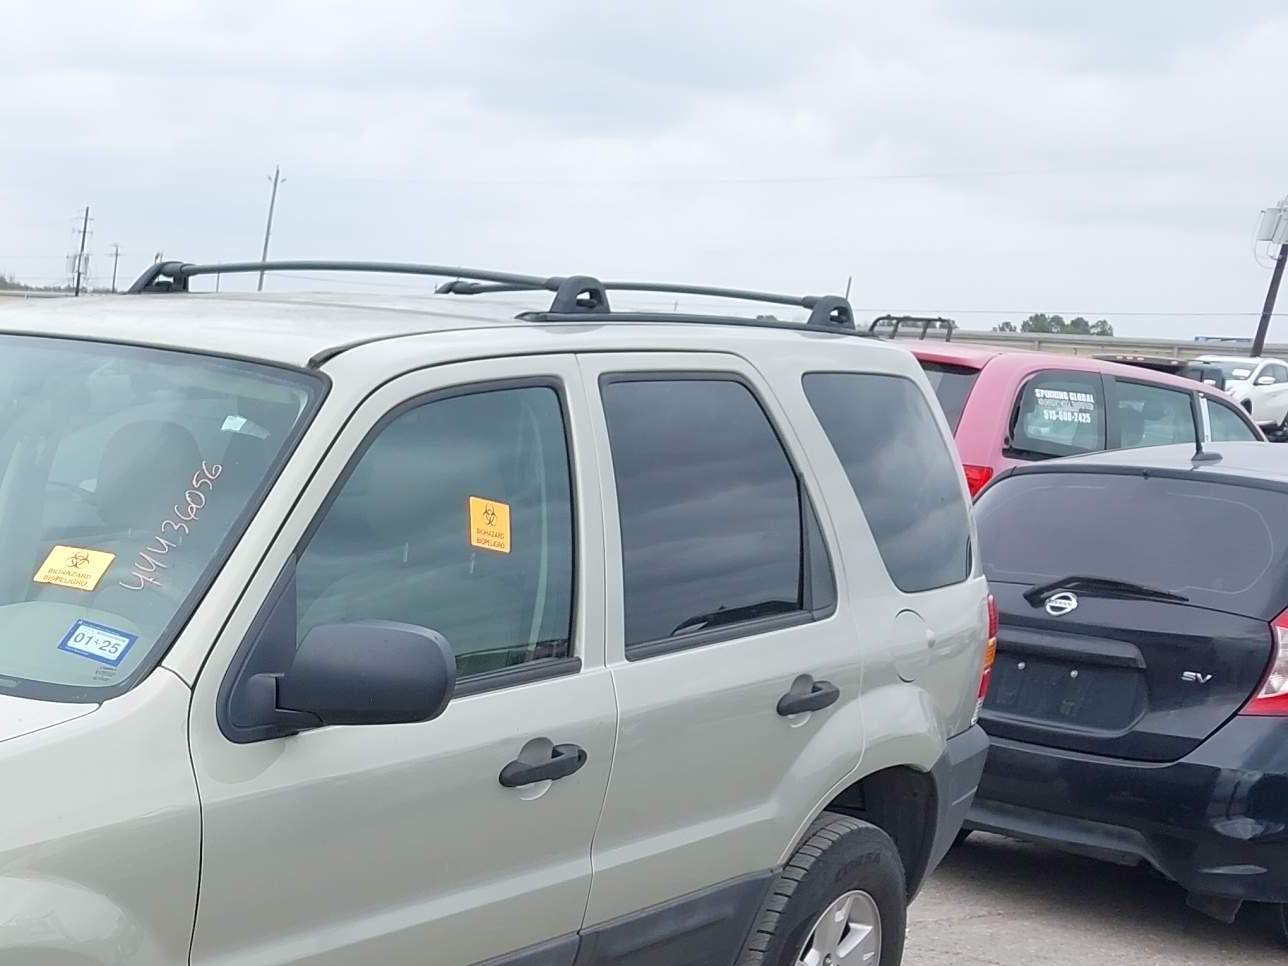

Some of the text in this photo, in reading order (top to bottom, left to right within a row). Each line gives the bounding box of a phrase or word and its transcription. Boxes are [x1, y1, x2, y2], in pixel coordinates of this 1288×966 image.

[119, 460, 223, 590] 44436056
[477, 527, 505, 540] BIOHAZARD
[48, 567, 92, 580] BIOHAZARD
[1181, 671, 1213, 683] SV
